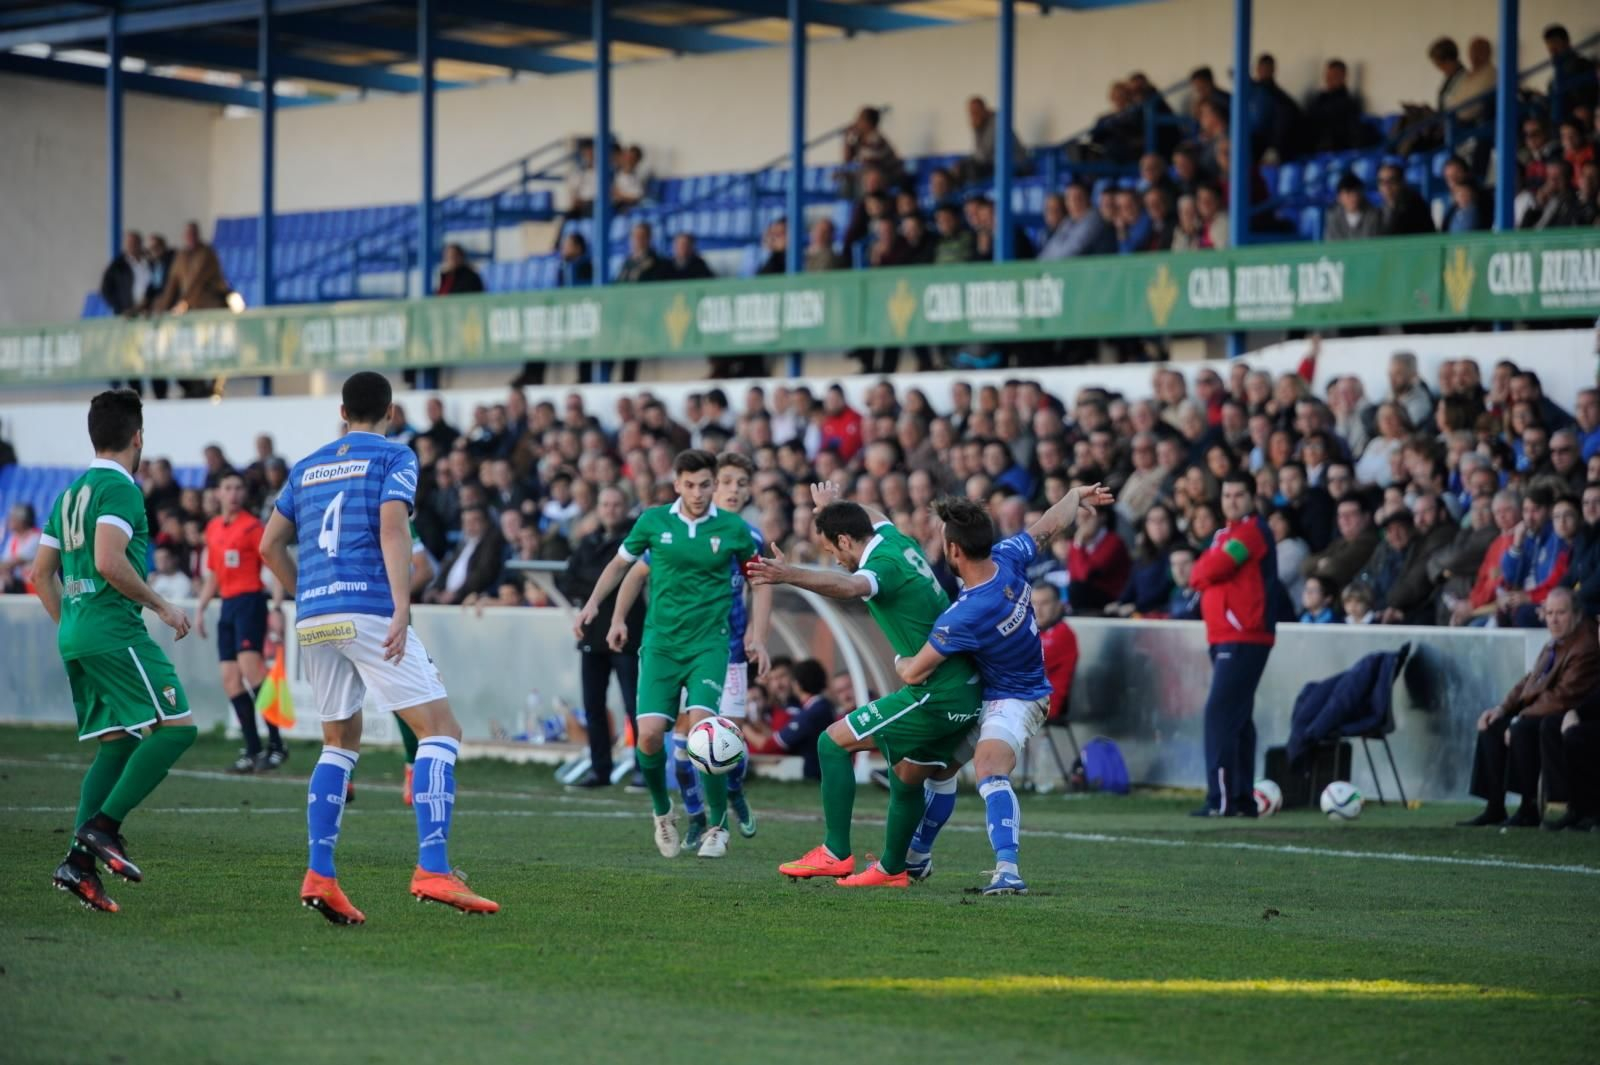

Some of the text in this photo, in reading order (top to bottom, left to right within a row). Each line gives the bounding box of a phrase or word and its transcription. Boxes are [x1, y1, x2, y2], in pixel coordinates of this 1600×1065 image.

[1488, 251, 1534, 296] CAJA
[304, 464, 366, 481] ratiopharm
[62, 485, 91, 552] 10
[318, 491, 344, 557] 4
